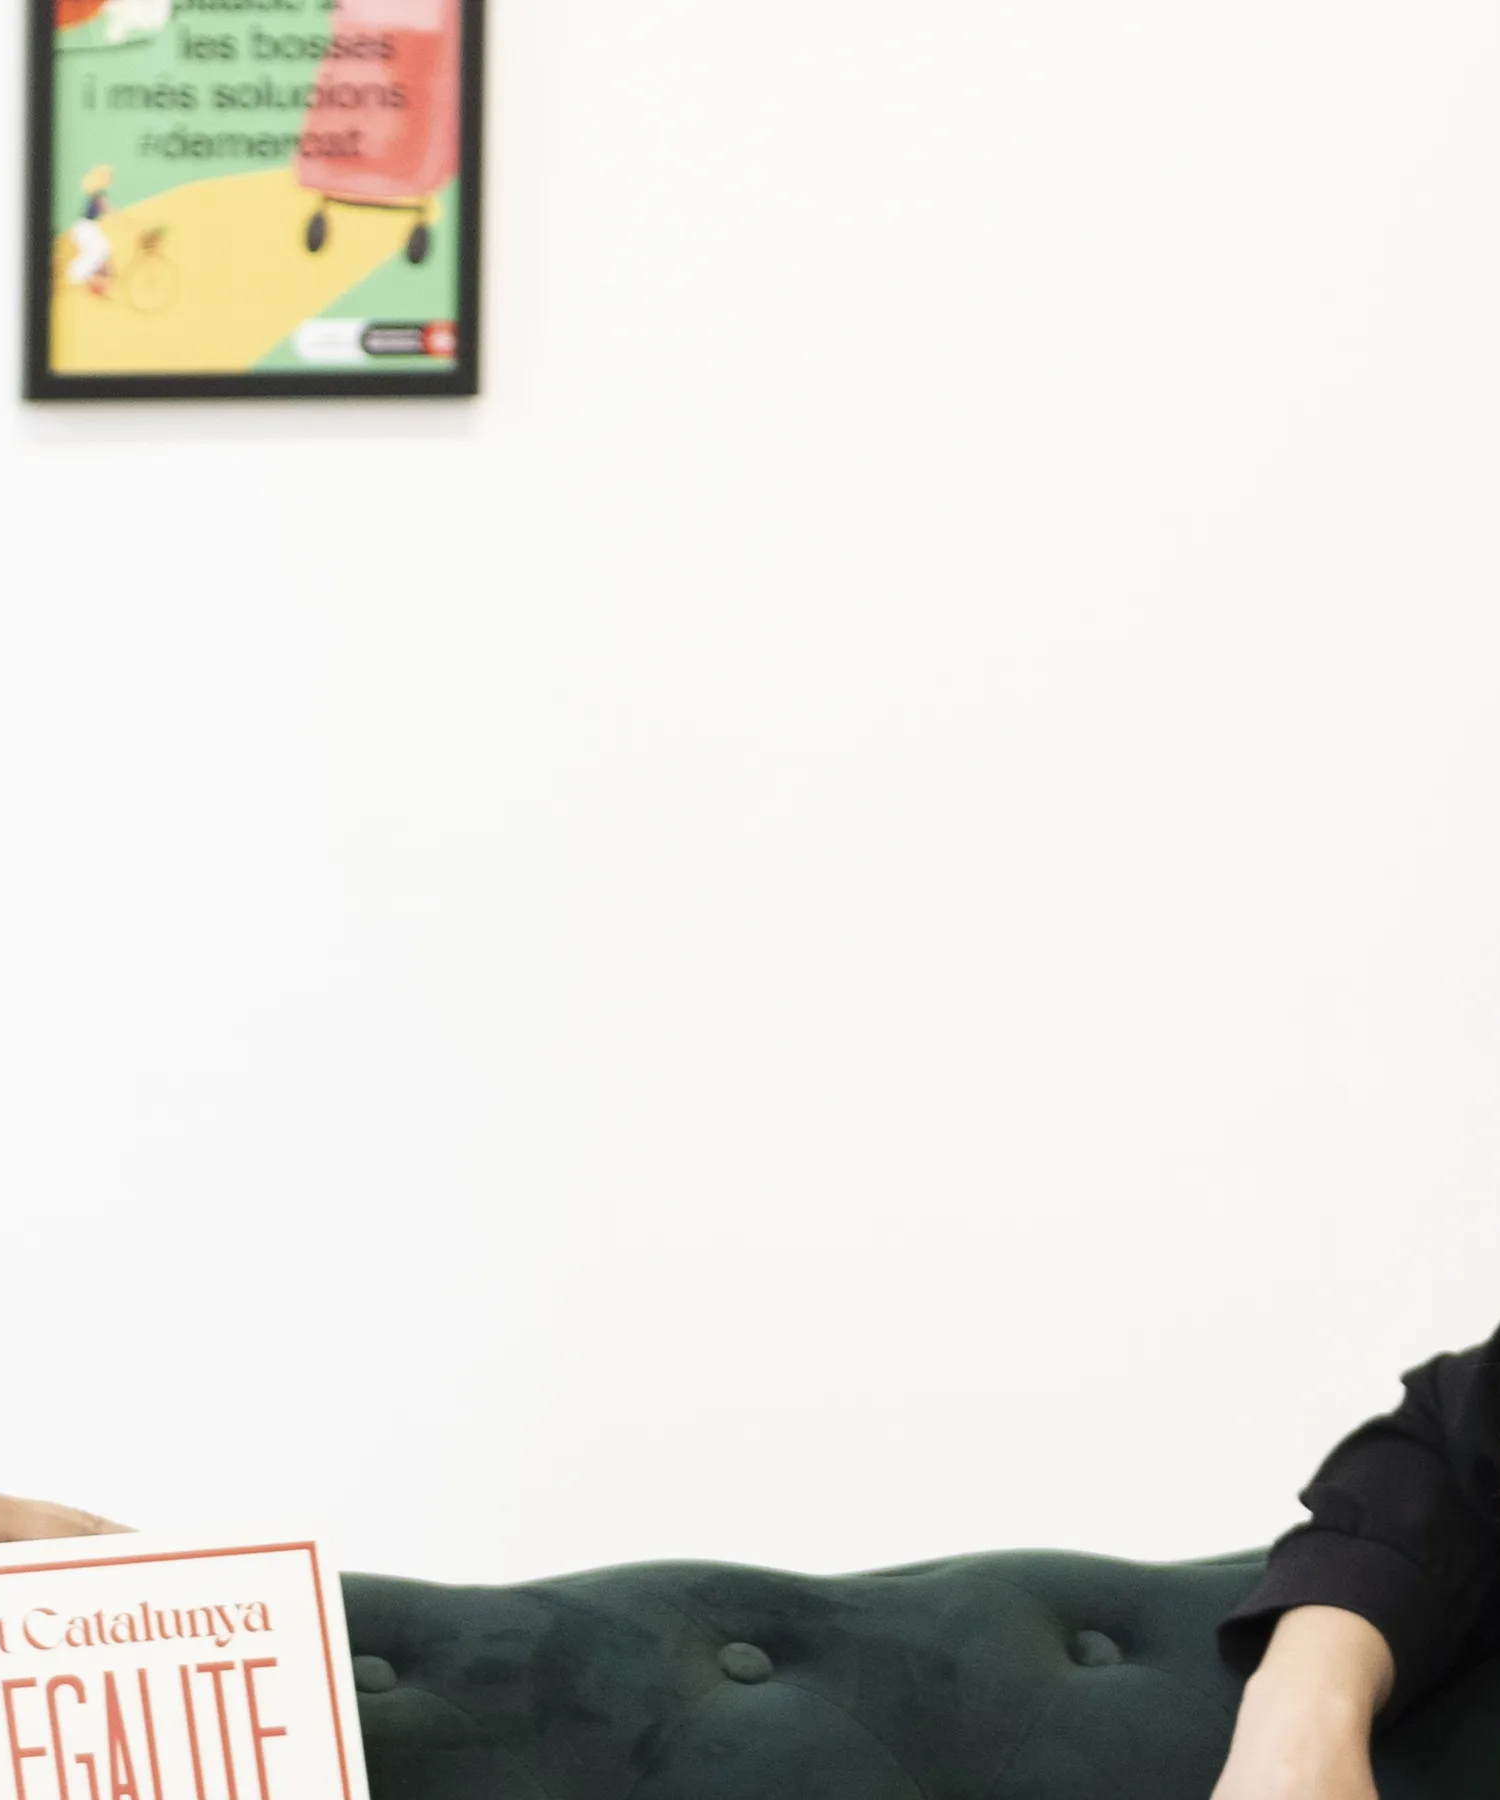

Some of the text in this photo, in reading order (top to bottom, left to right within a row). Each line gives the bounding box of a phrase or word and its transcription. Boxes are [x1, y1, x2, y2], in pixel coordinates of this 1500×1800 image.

[180, 22, 397, 62] les bosses
[209, 76, 408, 111] solucions
[21, 1600, 274, 1650] Catalunya
